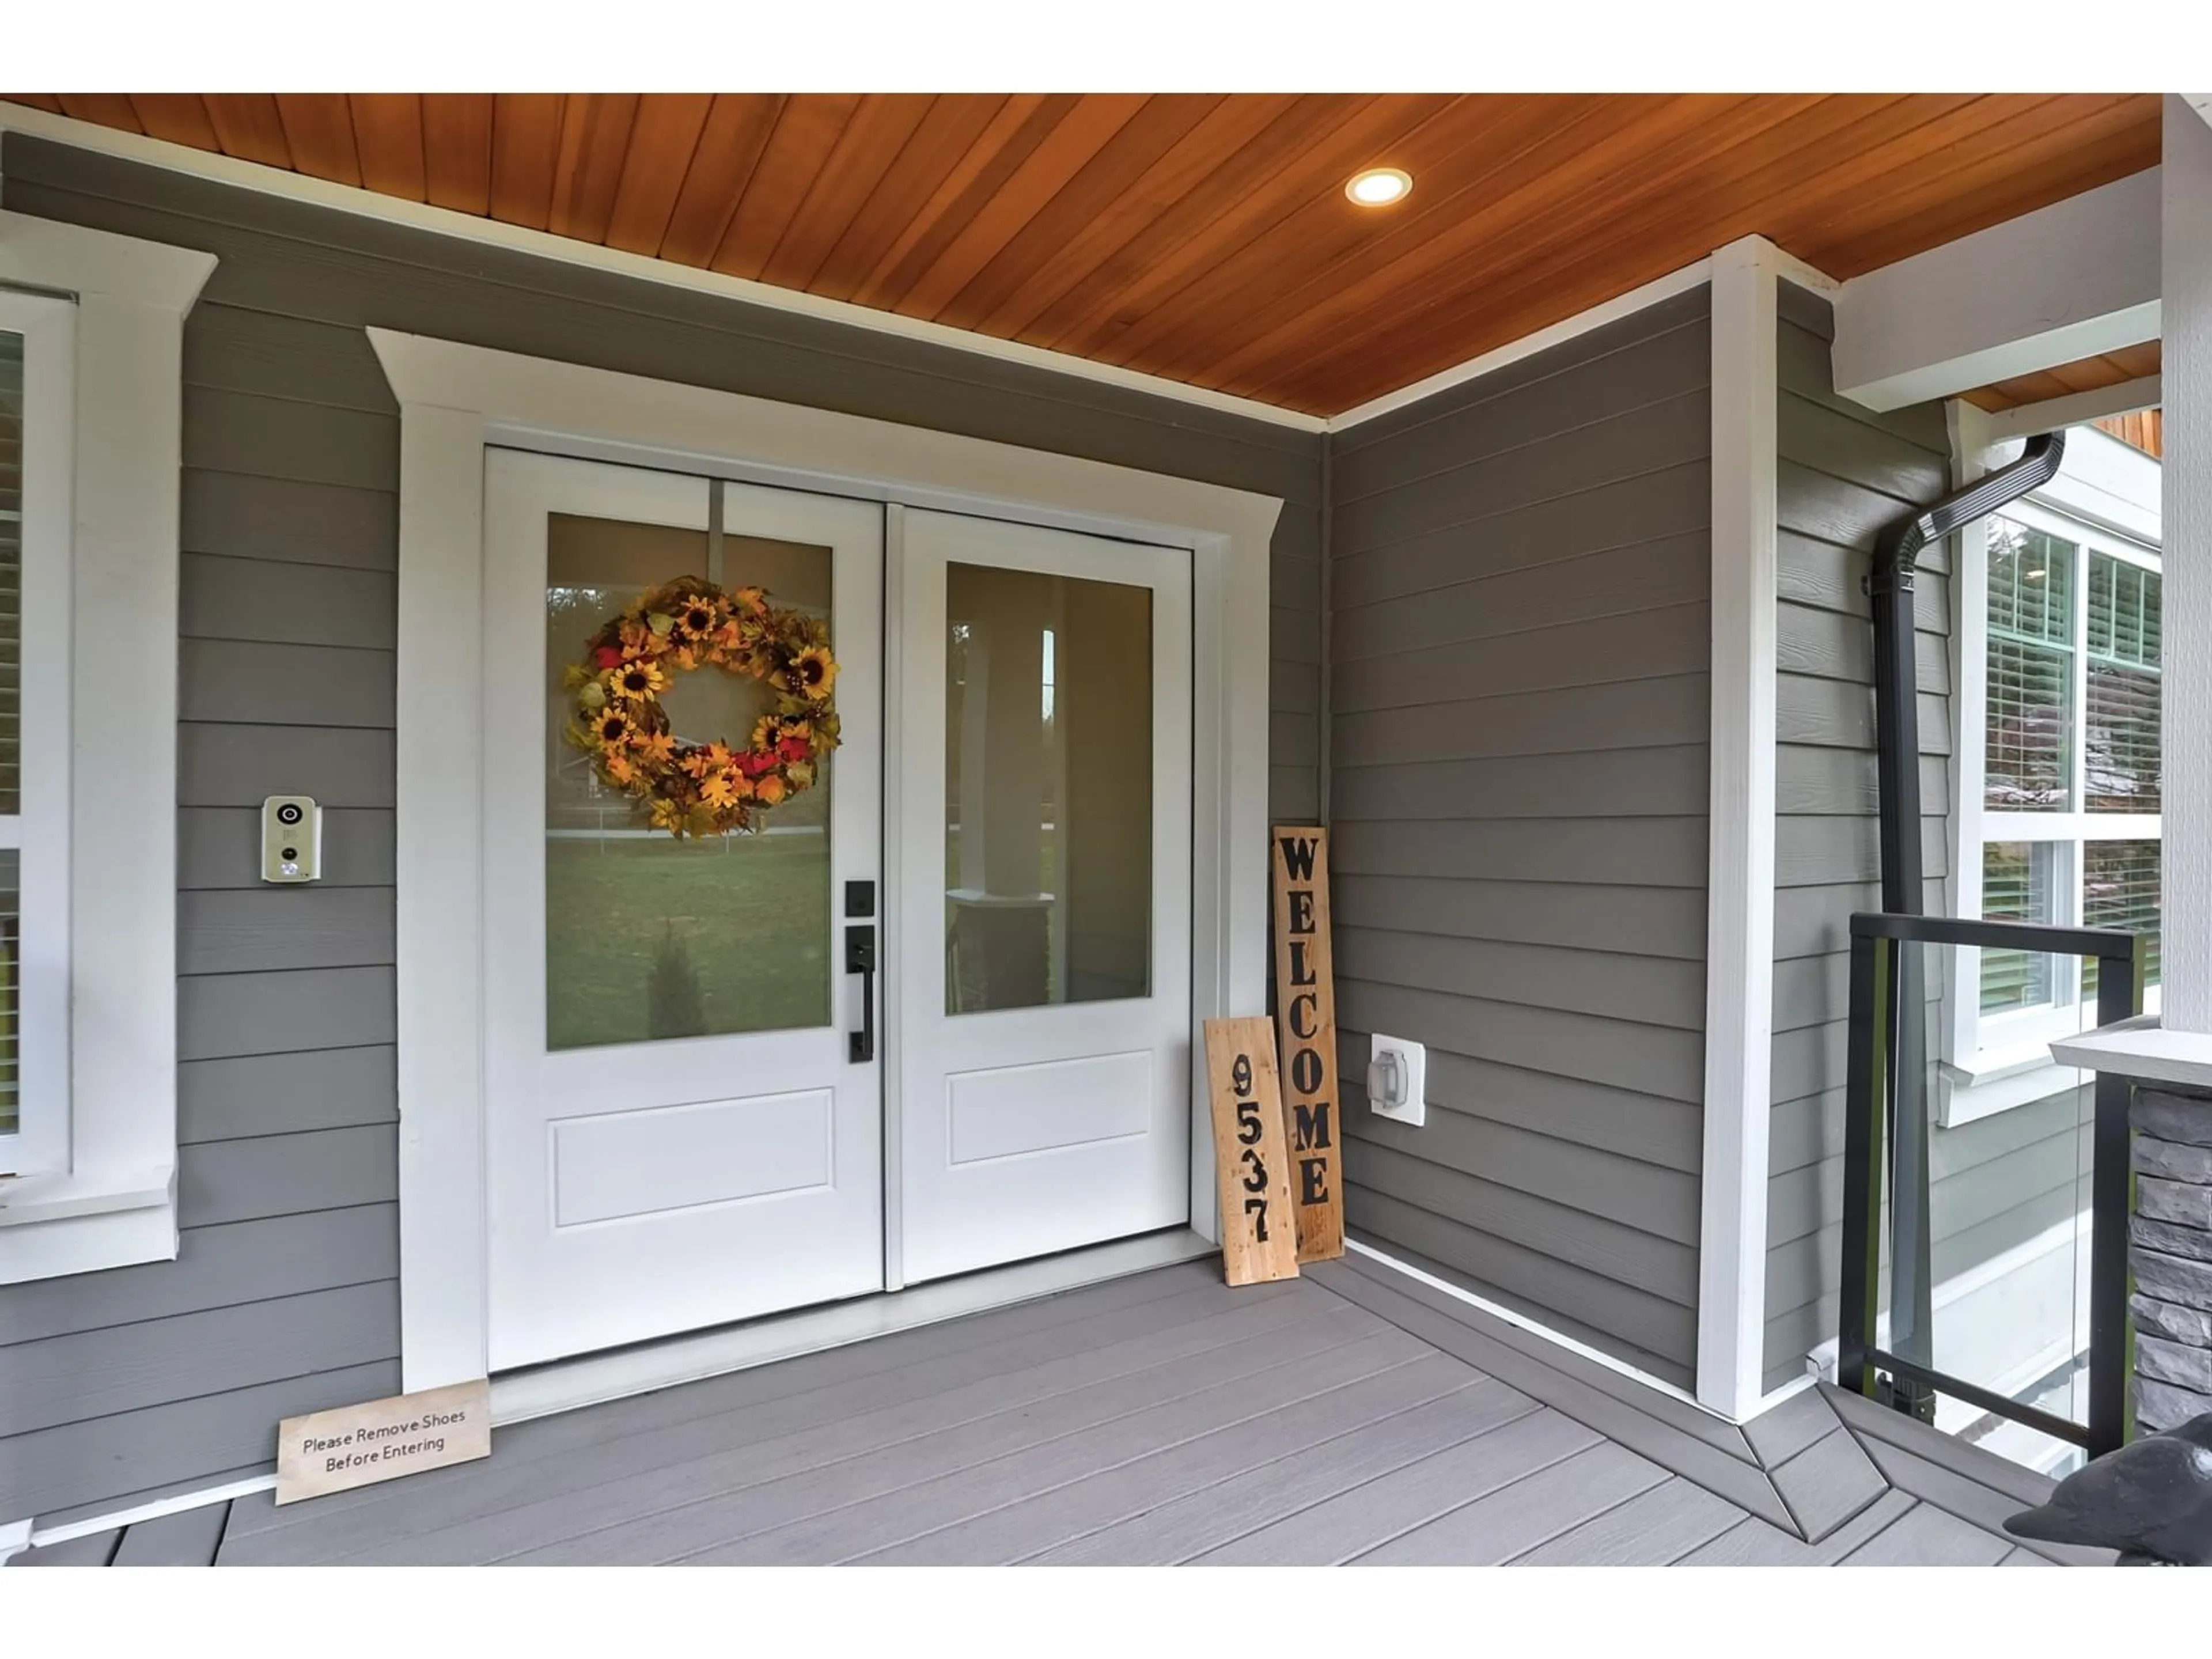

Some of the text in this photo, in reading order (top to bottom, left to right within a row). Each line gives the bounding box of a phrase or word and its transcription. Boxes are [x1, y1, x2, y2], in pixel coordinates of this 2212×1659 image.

[1279, 837, 1331, 1206] WELCOME
[1232, 1053, 1269, 1243] 9537
[303, 1410, 465, 1455] Please Remove Shoes
[325, 1437, 445, 1472] Before Entering
